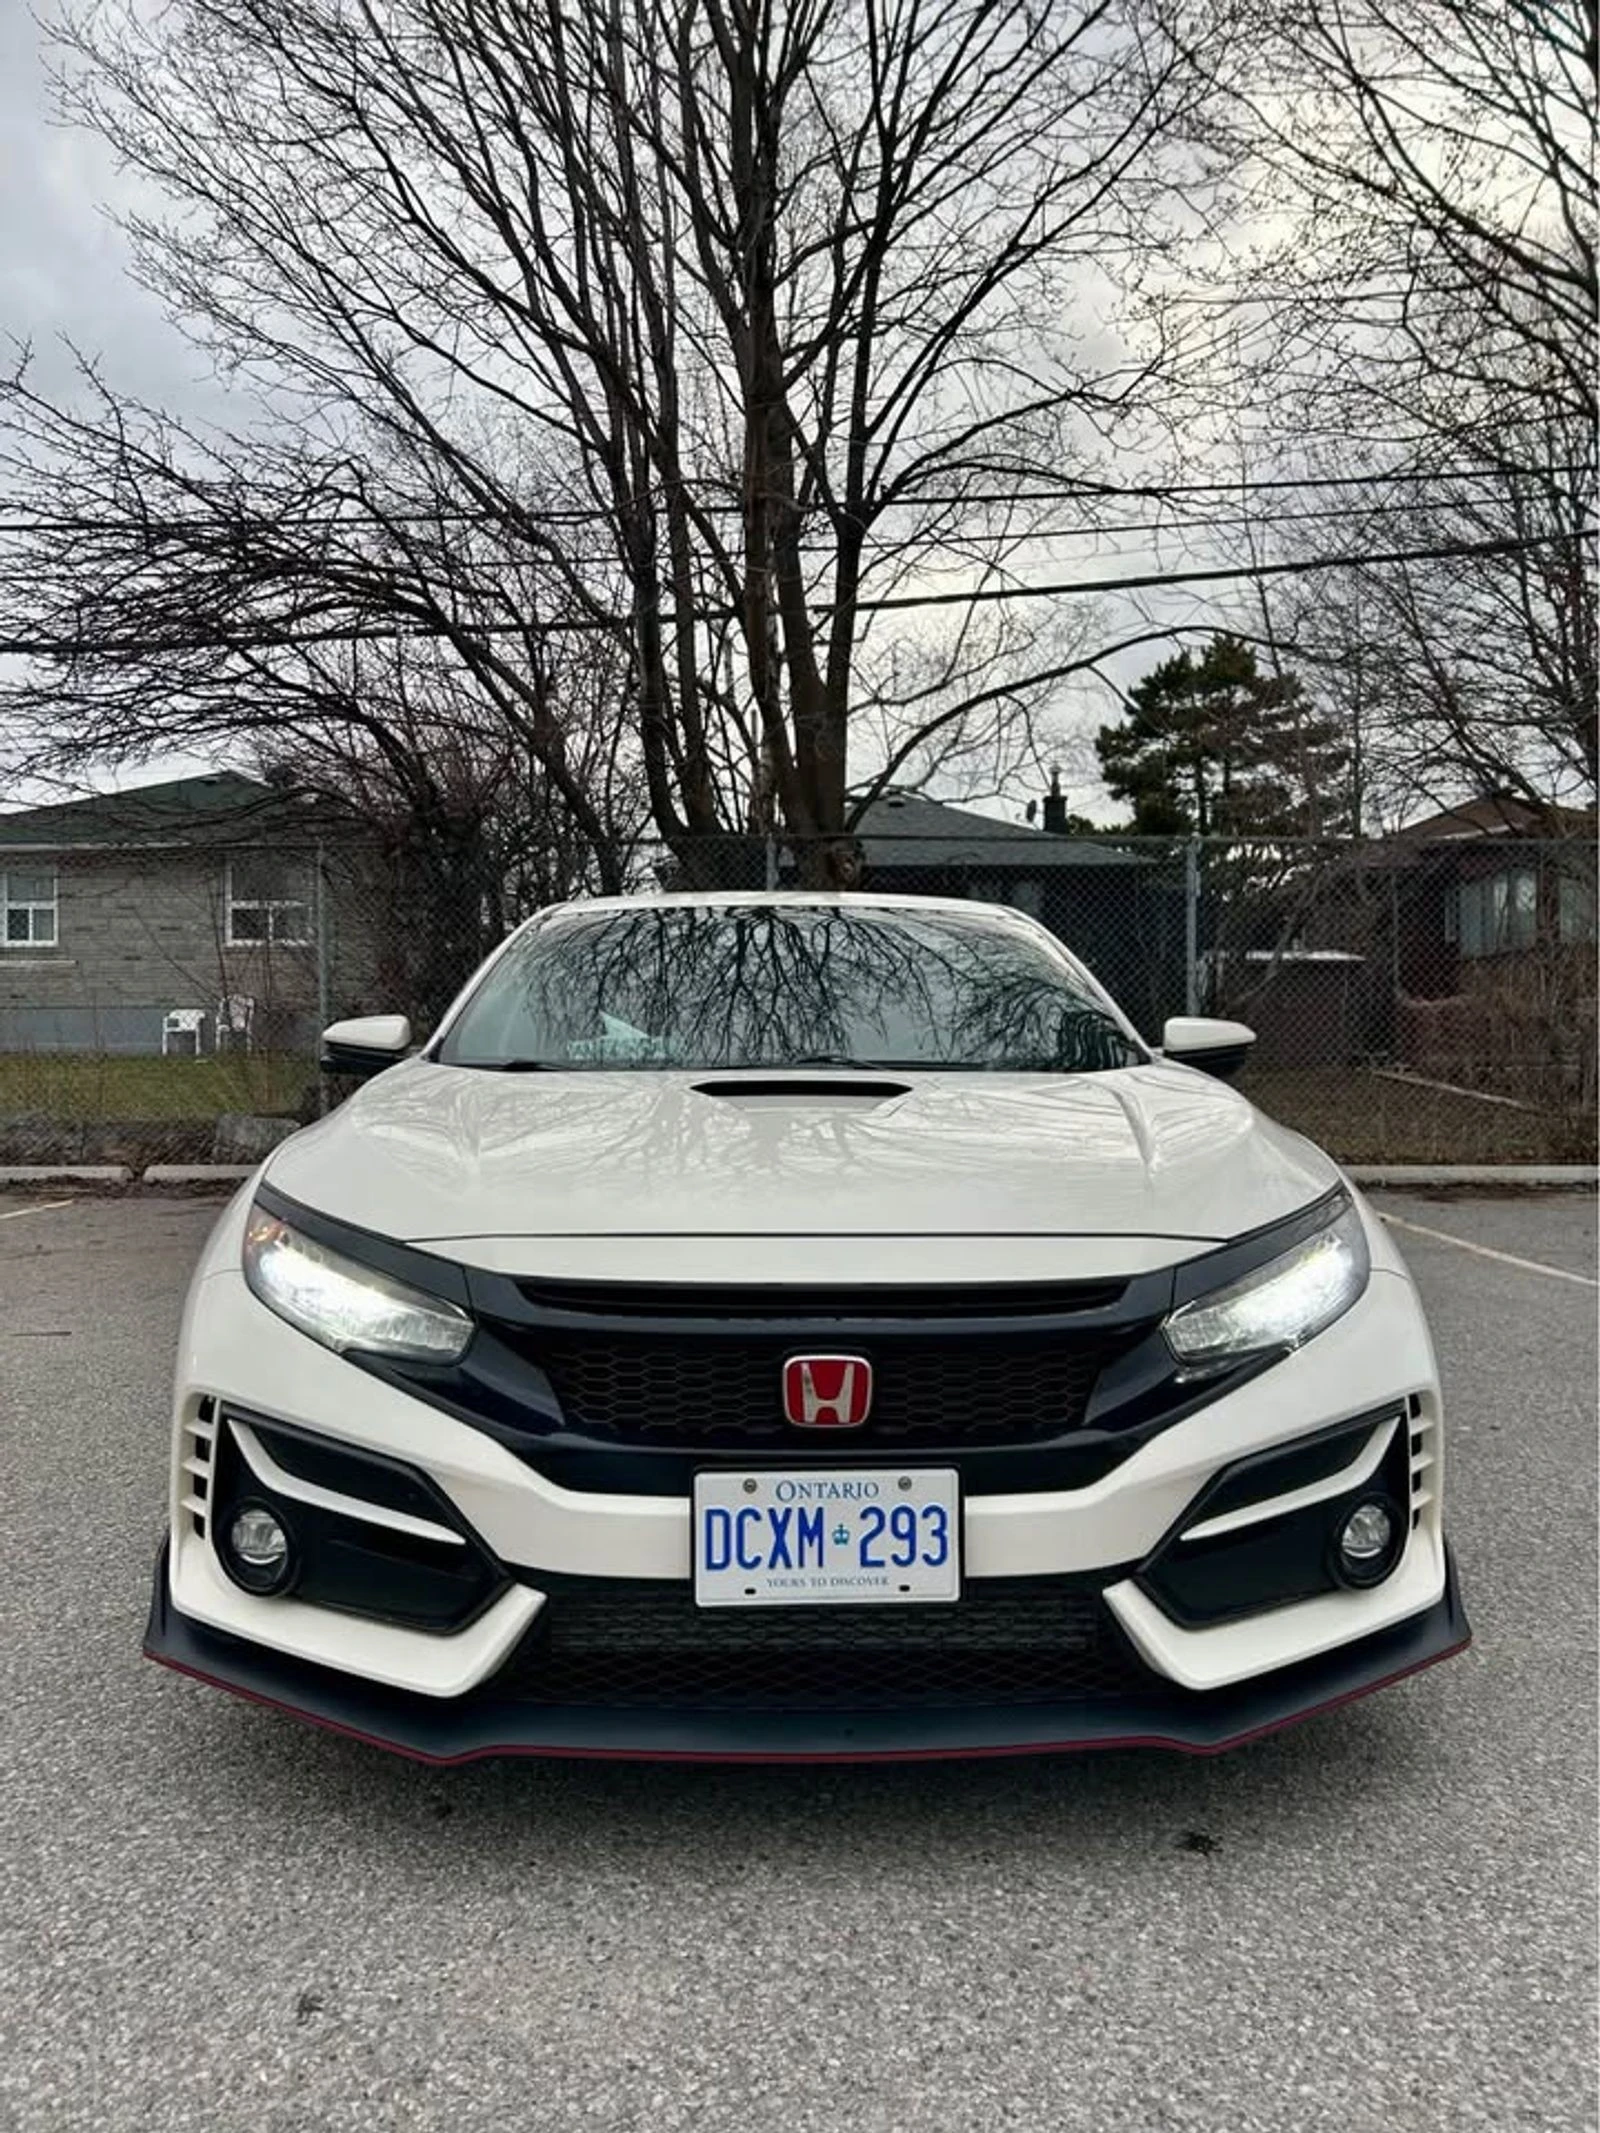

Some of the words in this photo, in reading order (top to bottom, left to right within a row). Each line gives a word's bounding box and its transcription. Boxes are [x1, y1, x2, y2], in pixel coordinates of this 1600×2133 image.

[775, 1480, 880, 1501] ONTARIO
[704, 1506, 824, 1571] DCXM
[859, 1505, 948, 1568] 293
